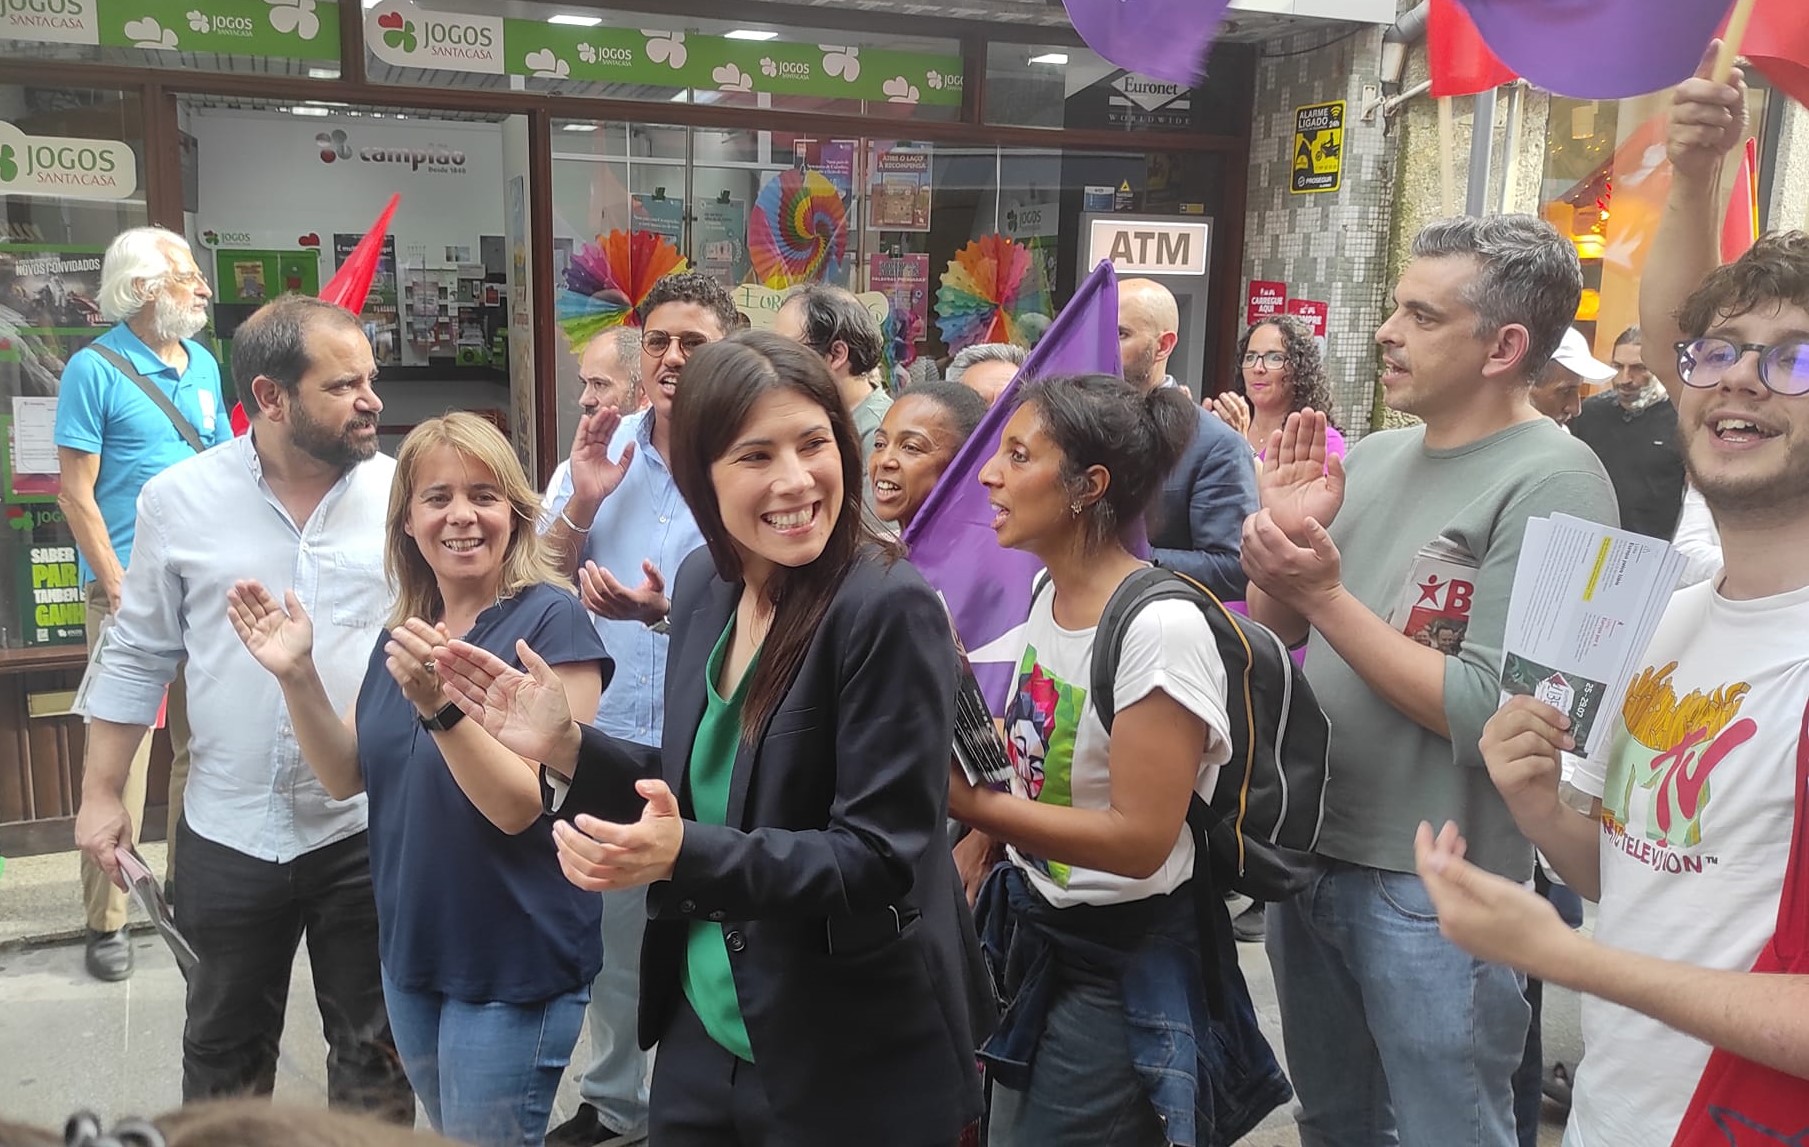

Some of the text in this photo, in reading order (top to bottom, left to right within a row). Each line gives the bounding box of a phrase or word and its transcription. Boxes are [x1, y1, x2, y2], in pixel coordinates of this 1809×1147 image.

[212, 15, 253, 31] JOGOS
[424, 23, 493, 48] JOGOS
[431, 47, 493, 60] SANTACASA
[598, 46, 632, 61] JOGOS
[778, 61, 810, 75] JOGOS
[1124, 76, 1178, 95] Euronet
[1109, 114, 1191, 125] WORLDWIDE
[1300, 108, 1329, 120] ALARME
[1298, 116, 1328, 129] LIGADO
[26, 145, 116, 176] JOGOS
[37, 171, 116, 187] SANTACASA
[1305, 175, 1333, 185] PROSEGUR
[222, 232, 251, 243] JOGOS
[1109, 231, 1191, 265] ATM
[46, 258, 100, 273] CONVIDADOS
[1258, 304, 1275, 314] AQUI
[30, 546, 75, 564] SABER
[32, 563, 79, 588] PAR
[1443, 578, 1475, 613] B
[35, 602, 86, 627] GANH
